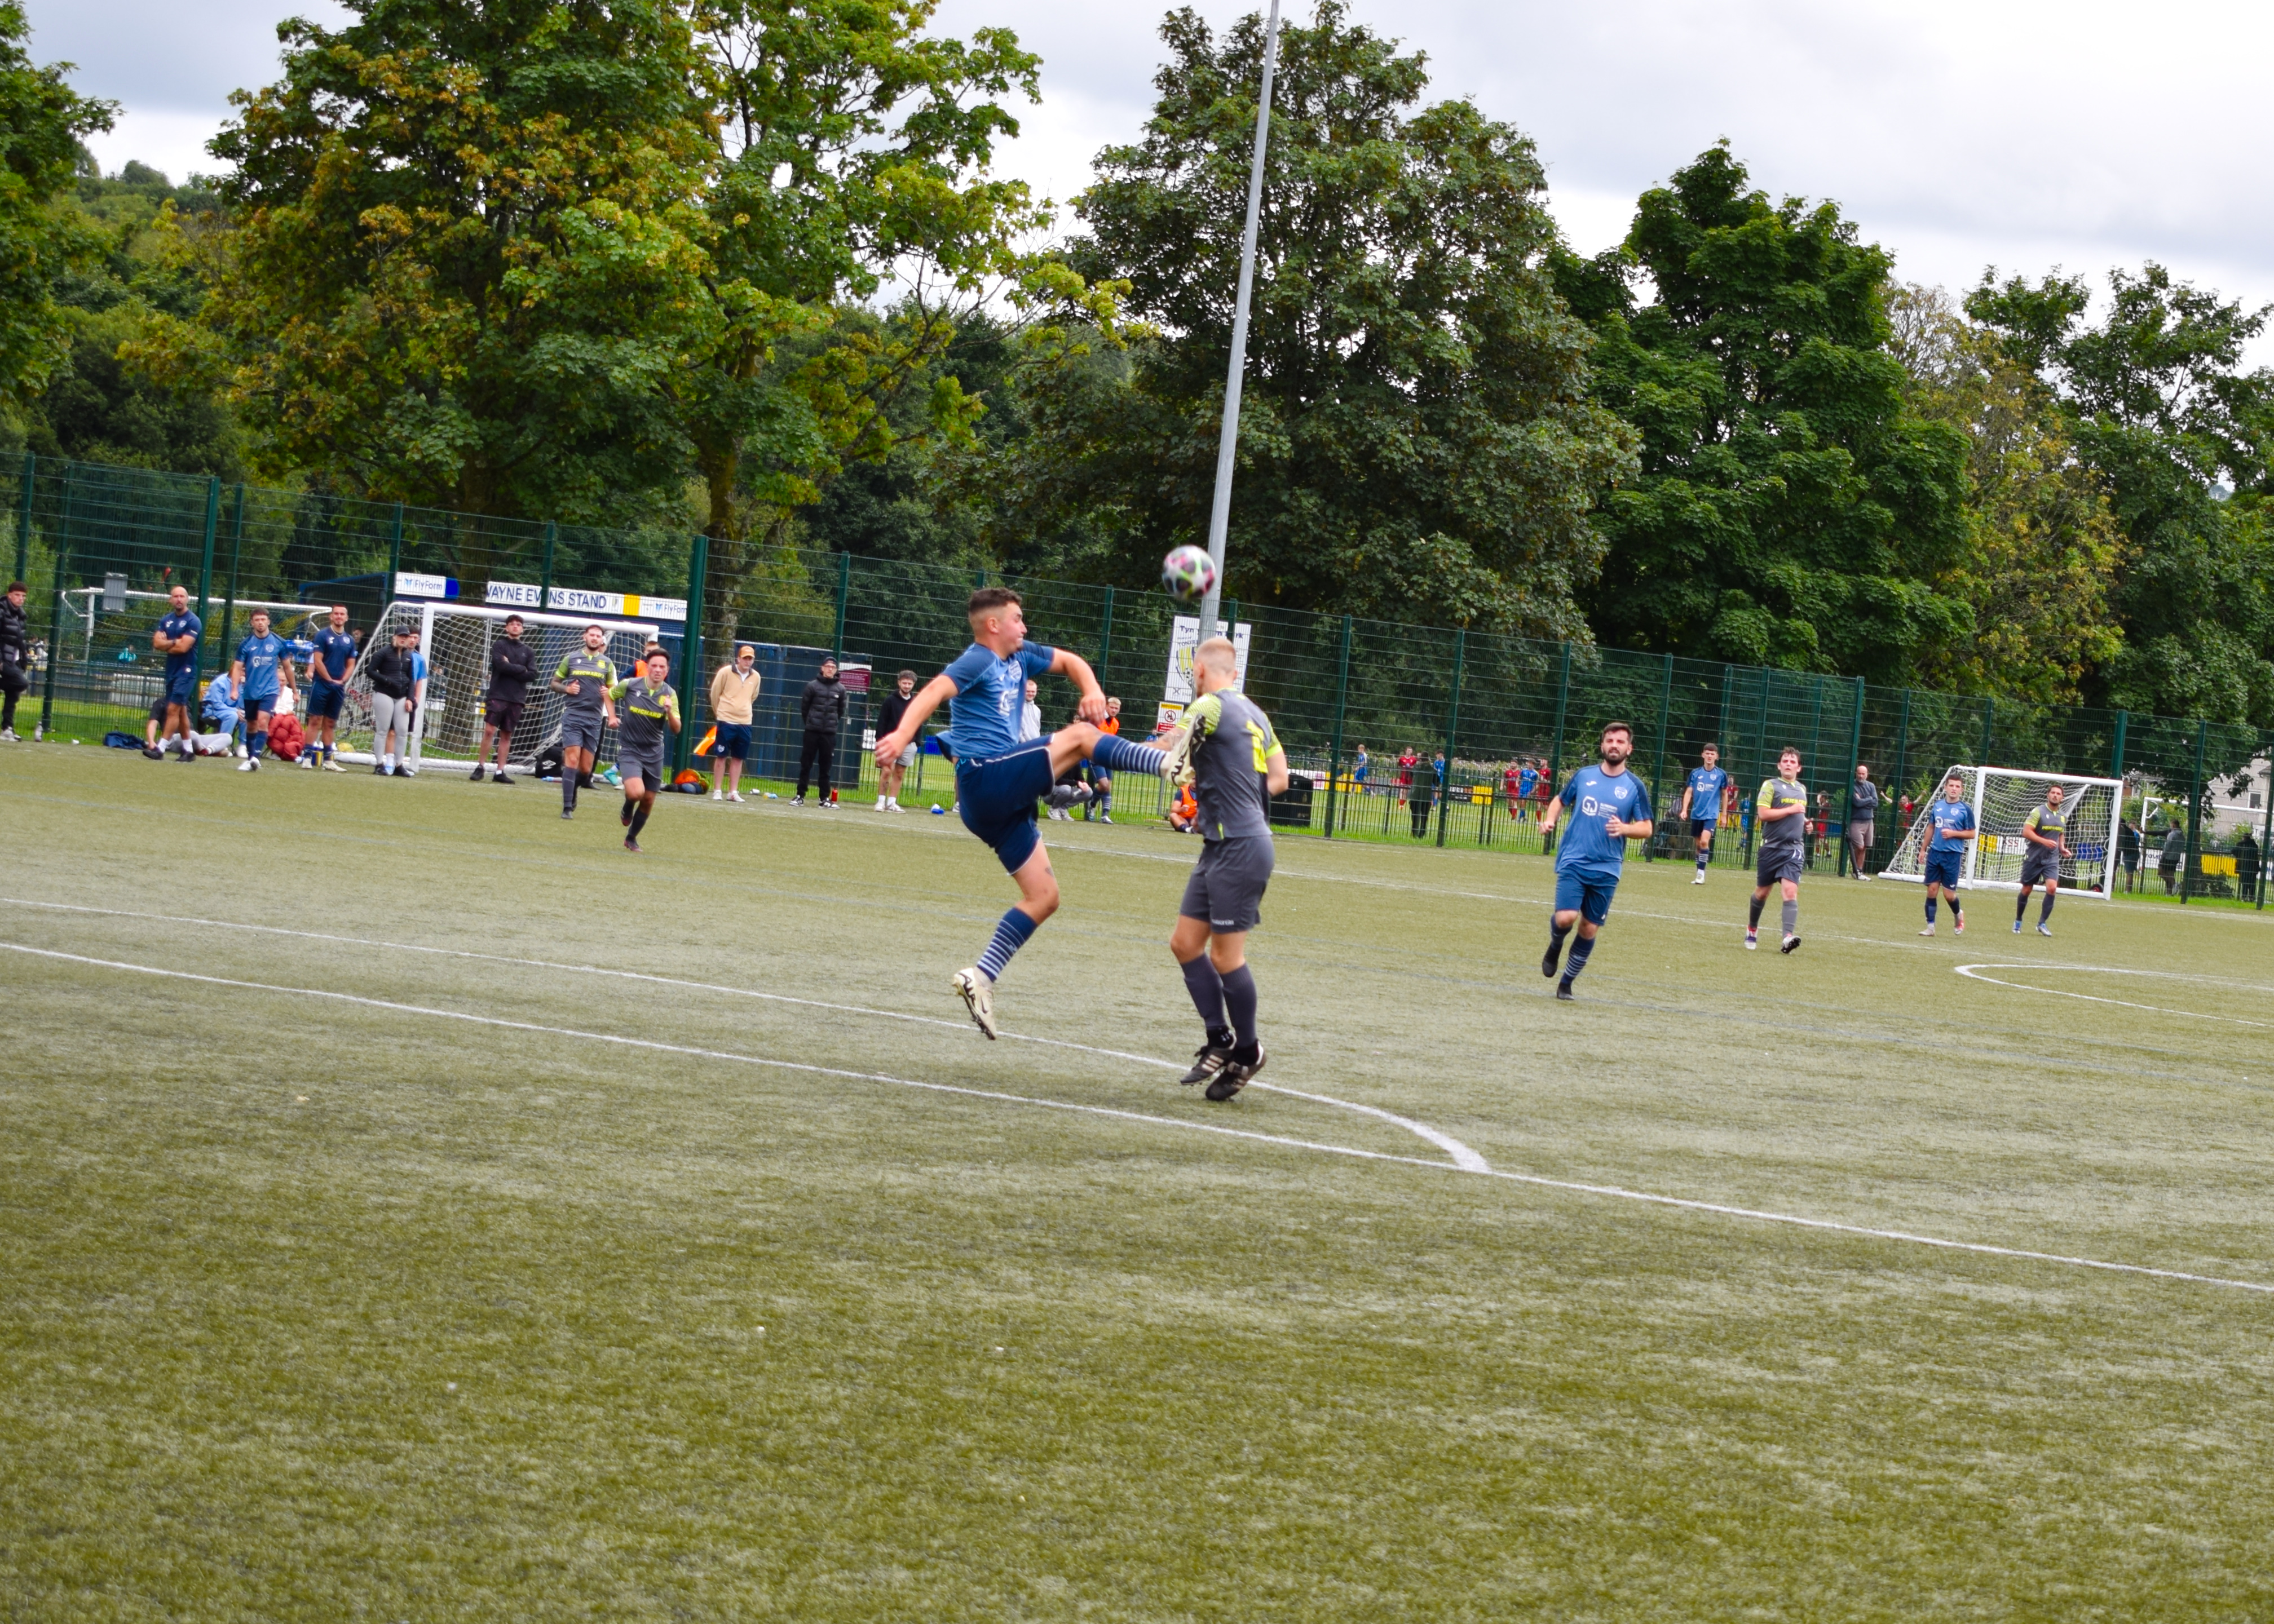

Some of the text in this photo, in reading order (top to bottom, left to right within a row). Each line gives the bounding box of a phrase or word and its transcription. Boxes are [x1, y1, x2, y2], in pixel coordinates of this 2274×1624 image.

[414, 579, 443, 590] FlyForm
[527, 589, 564, 605] EVNS
[568, 593, 607, 609] STAND
[1180, 625, 1194, 634] Tyn
